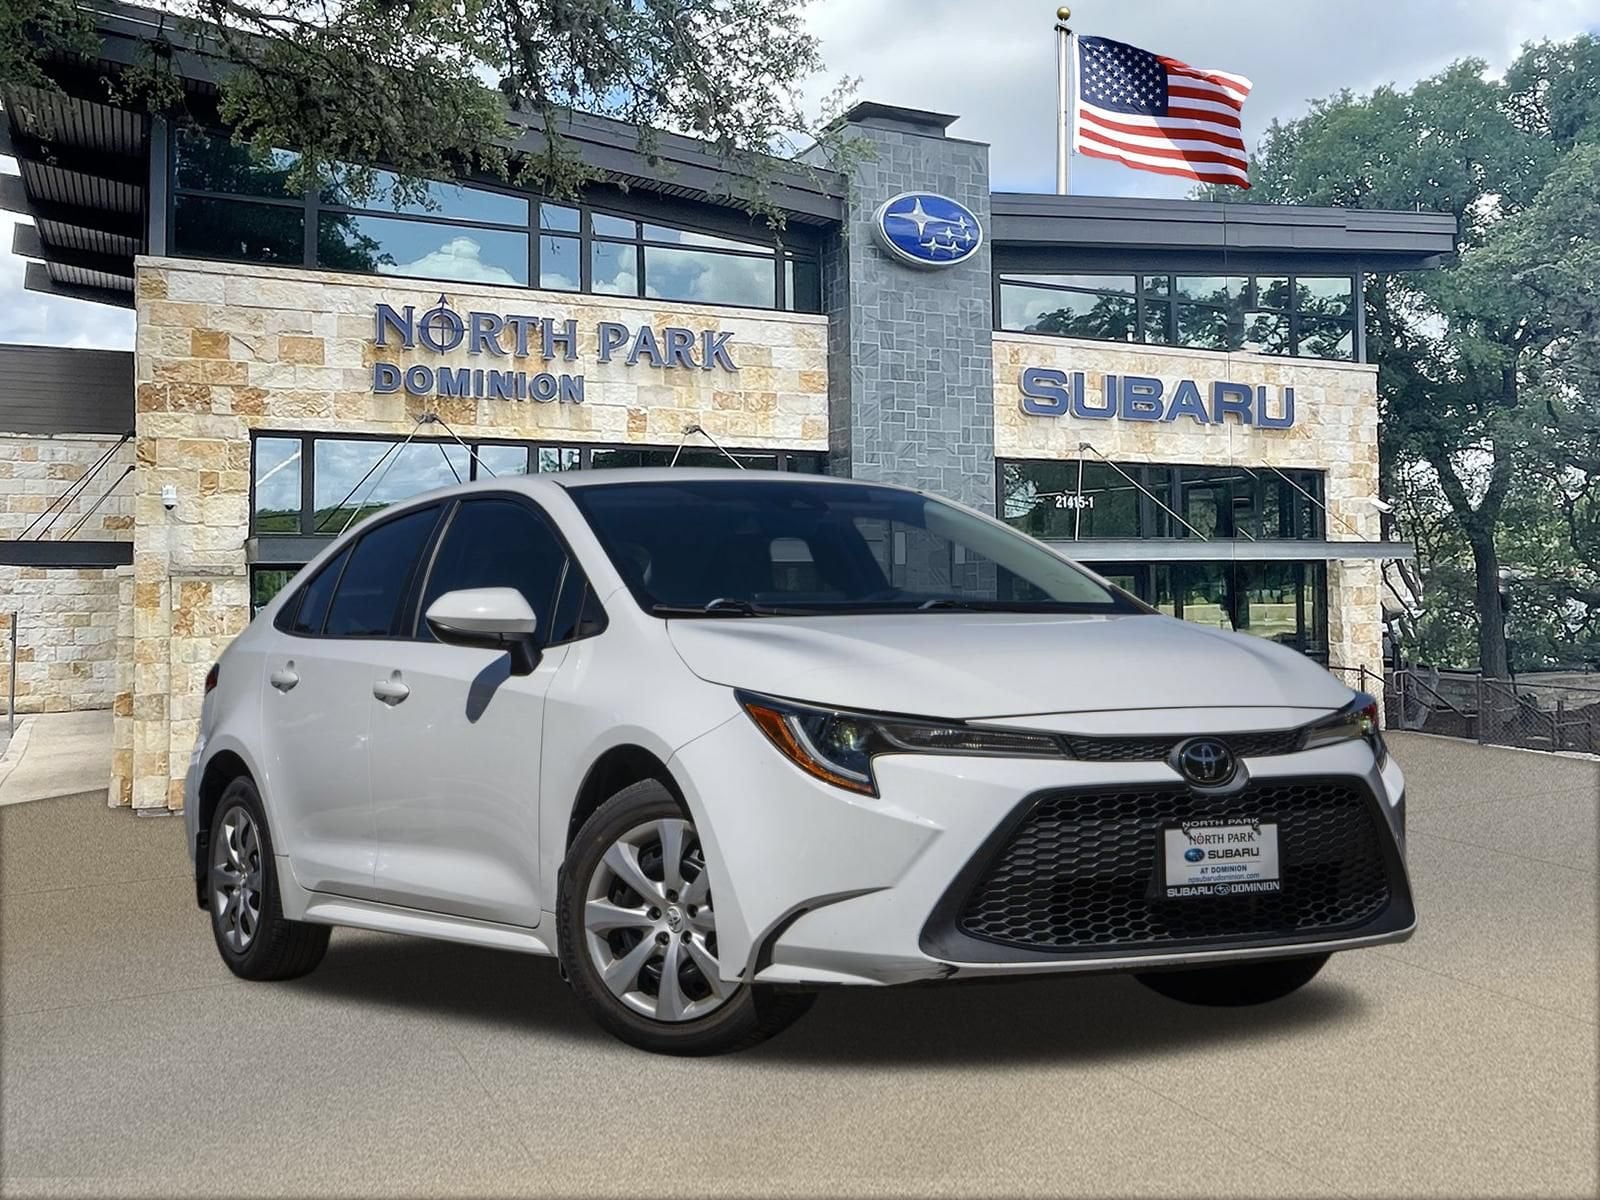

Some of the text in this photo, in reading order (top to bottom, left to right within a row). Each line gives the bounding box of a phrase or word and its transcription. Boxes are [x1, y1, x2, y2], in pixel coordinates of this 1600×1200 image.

[374, 294, 741, 373] NORTH PARK
[373, 362, 585, 404] DOMINION
[1019, 367, 1295, 429] SUBARU
[1182, 817, 1260, 828] NORTH PARK
[1189, 832, 1255, 845] NORTH PARK
[1207, 847, 1260, 860] SUBARU
[1200, 864, 1247, 875] AT DOMINION
[1166, 881, 1280, 898] SUBARU DOMINION
